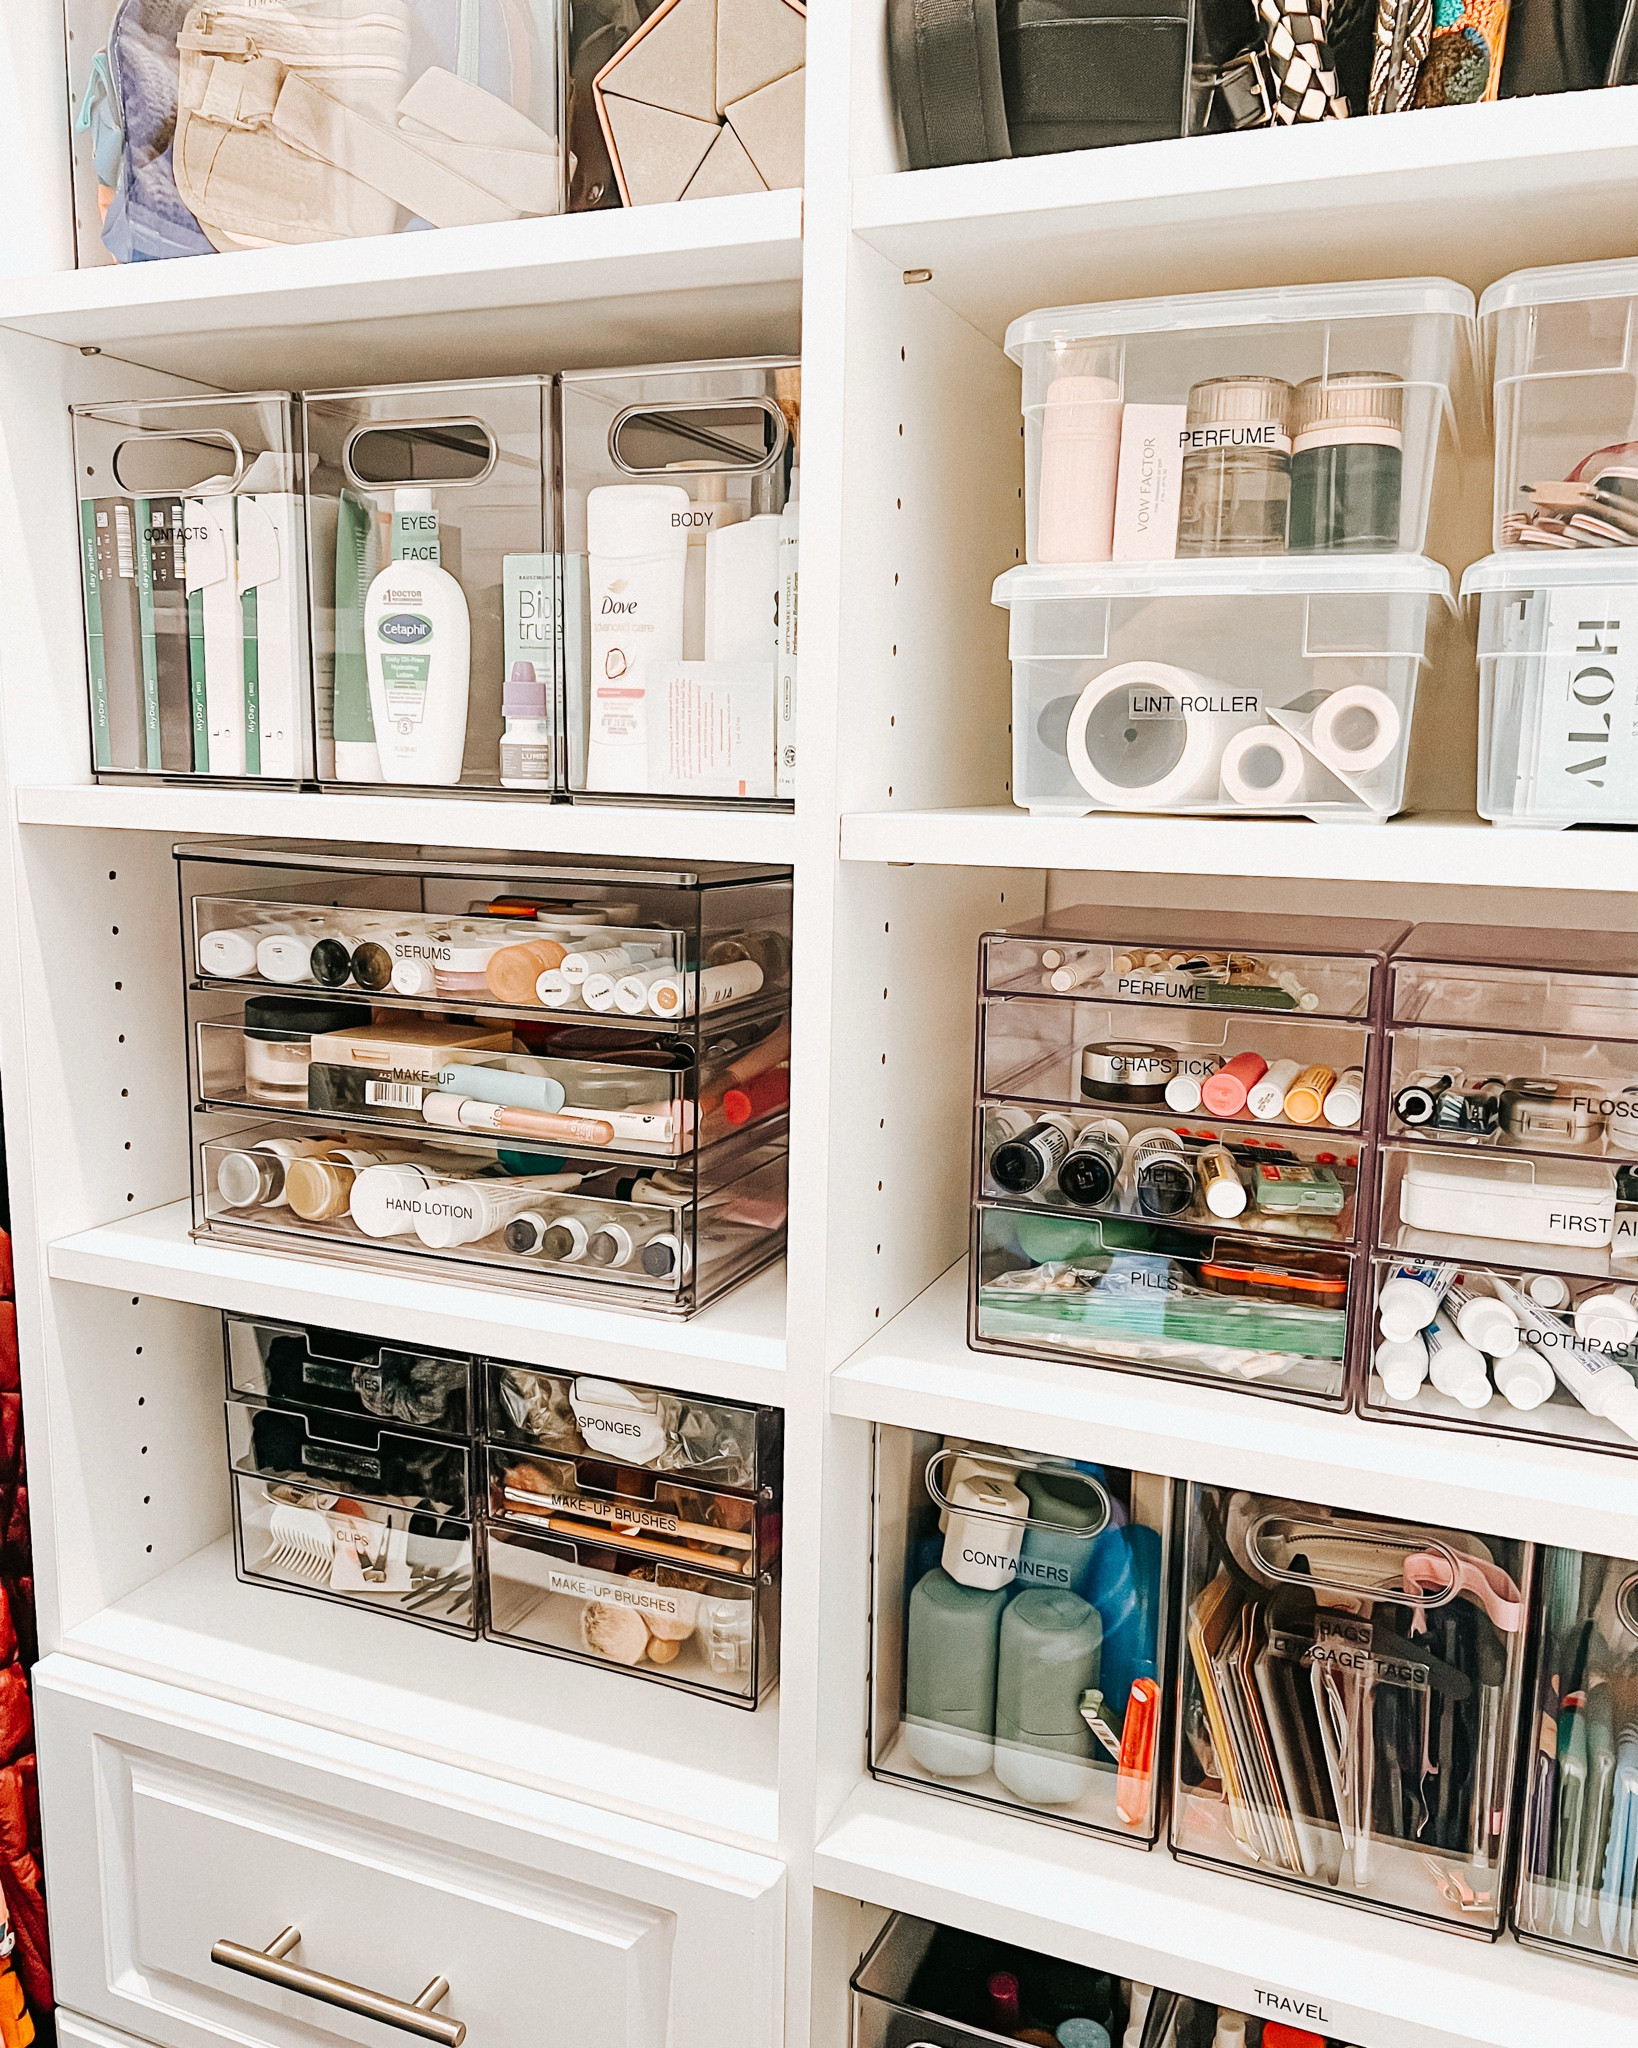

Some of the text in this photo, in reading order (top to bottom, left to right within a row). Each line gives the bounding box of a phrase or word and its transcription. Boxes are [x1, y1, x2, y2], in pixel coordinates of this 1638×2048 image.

[1179, 426, 1276, 449] PERFUME
[1137, 436, 1157, 533] VOW FACTOR
[401, 515, 437, 531] EYES
[671, 511, 714, 527] BODY
[143, 526, 208, 541] CONTACTS
[87, 538, 96, 571] asphere
[140, 538, 148, 571] asphere
[402, 546, 438, 560] FACE
[89, 573, 97, 588] day
[142, 573, 150, 588] day
[391, 590, 422, 598] DOCTOR
[601, 595, 638, 615] Dove
[383, 623, 426, 637] Cetaphil
[1133, 696, 1258, 713] LINT ROLLER
[394, 944, 452, 961] SERUMS
[1118, 978, 1206, 1000] PERFUME
[393, 1067, 455, 1085] MAKE-UP
[1110, 1056, 1215, 1076] CHAPSTICK
[1138, 1166, 1190, 1186] MEDS
[386, 1197, 473, 1220] HAND LOTION
[1549, 1213, 1612, 1234] FIRST
[1131, 1271, 1178, 1291] PILLS
[578, 1416, 642, 1438] SPONGES
[551, 1494, 677, 1532] MAKE-UP BRUSHES
[336, 1530, 369, 1546] CLIPS
[962, 1549, 1069, 1583] CONTAINERS
[551, 1576, 676, 1614] MAKE-UP BRUSHES
[1319, 1621, 1371, 1644] BAGS
[1373, 1660, 1425, 1684] TAGS
[1253, 1988, 1329, 2023] TRAVEL
